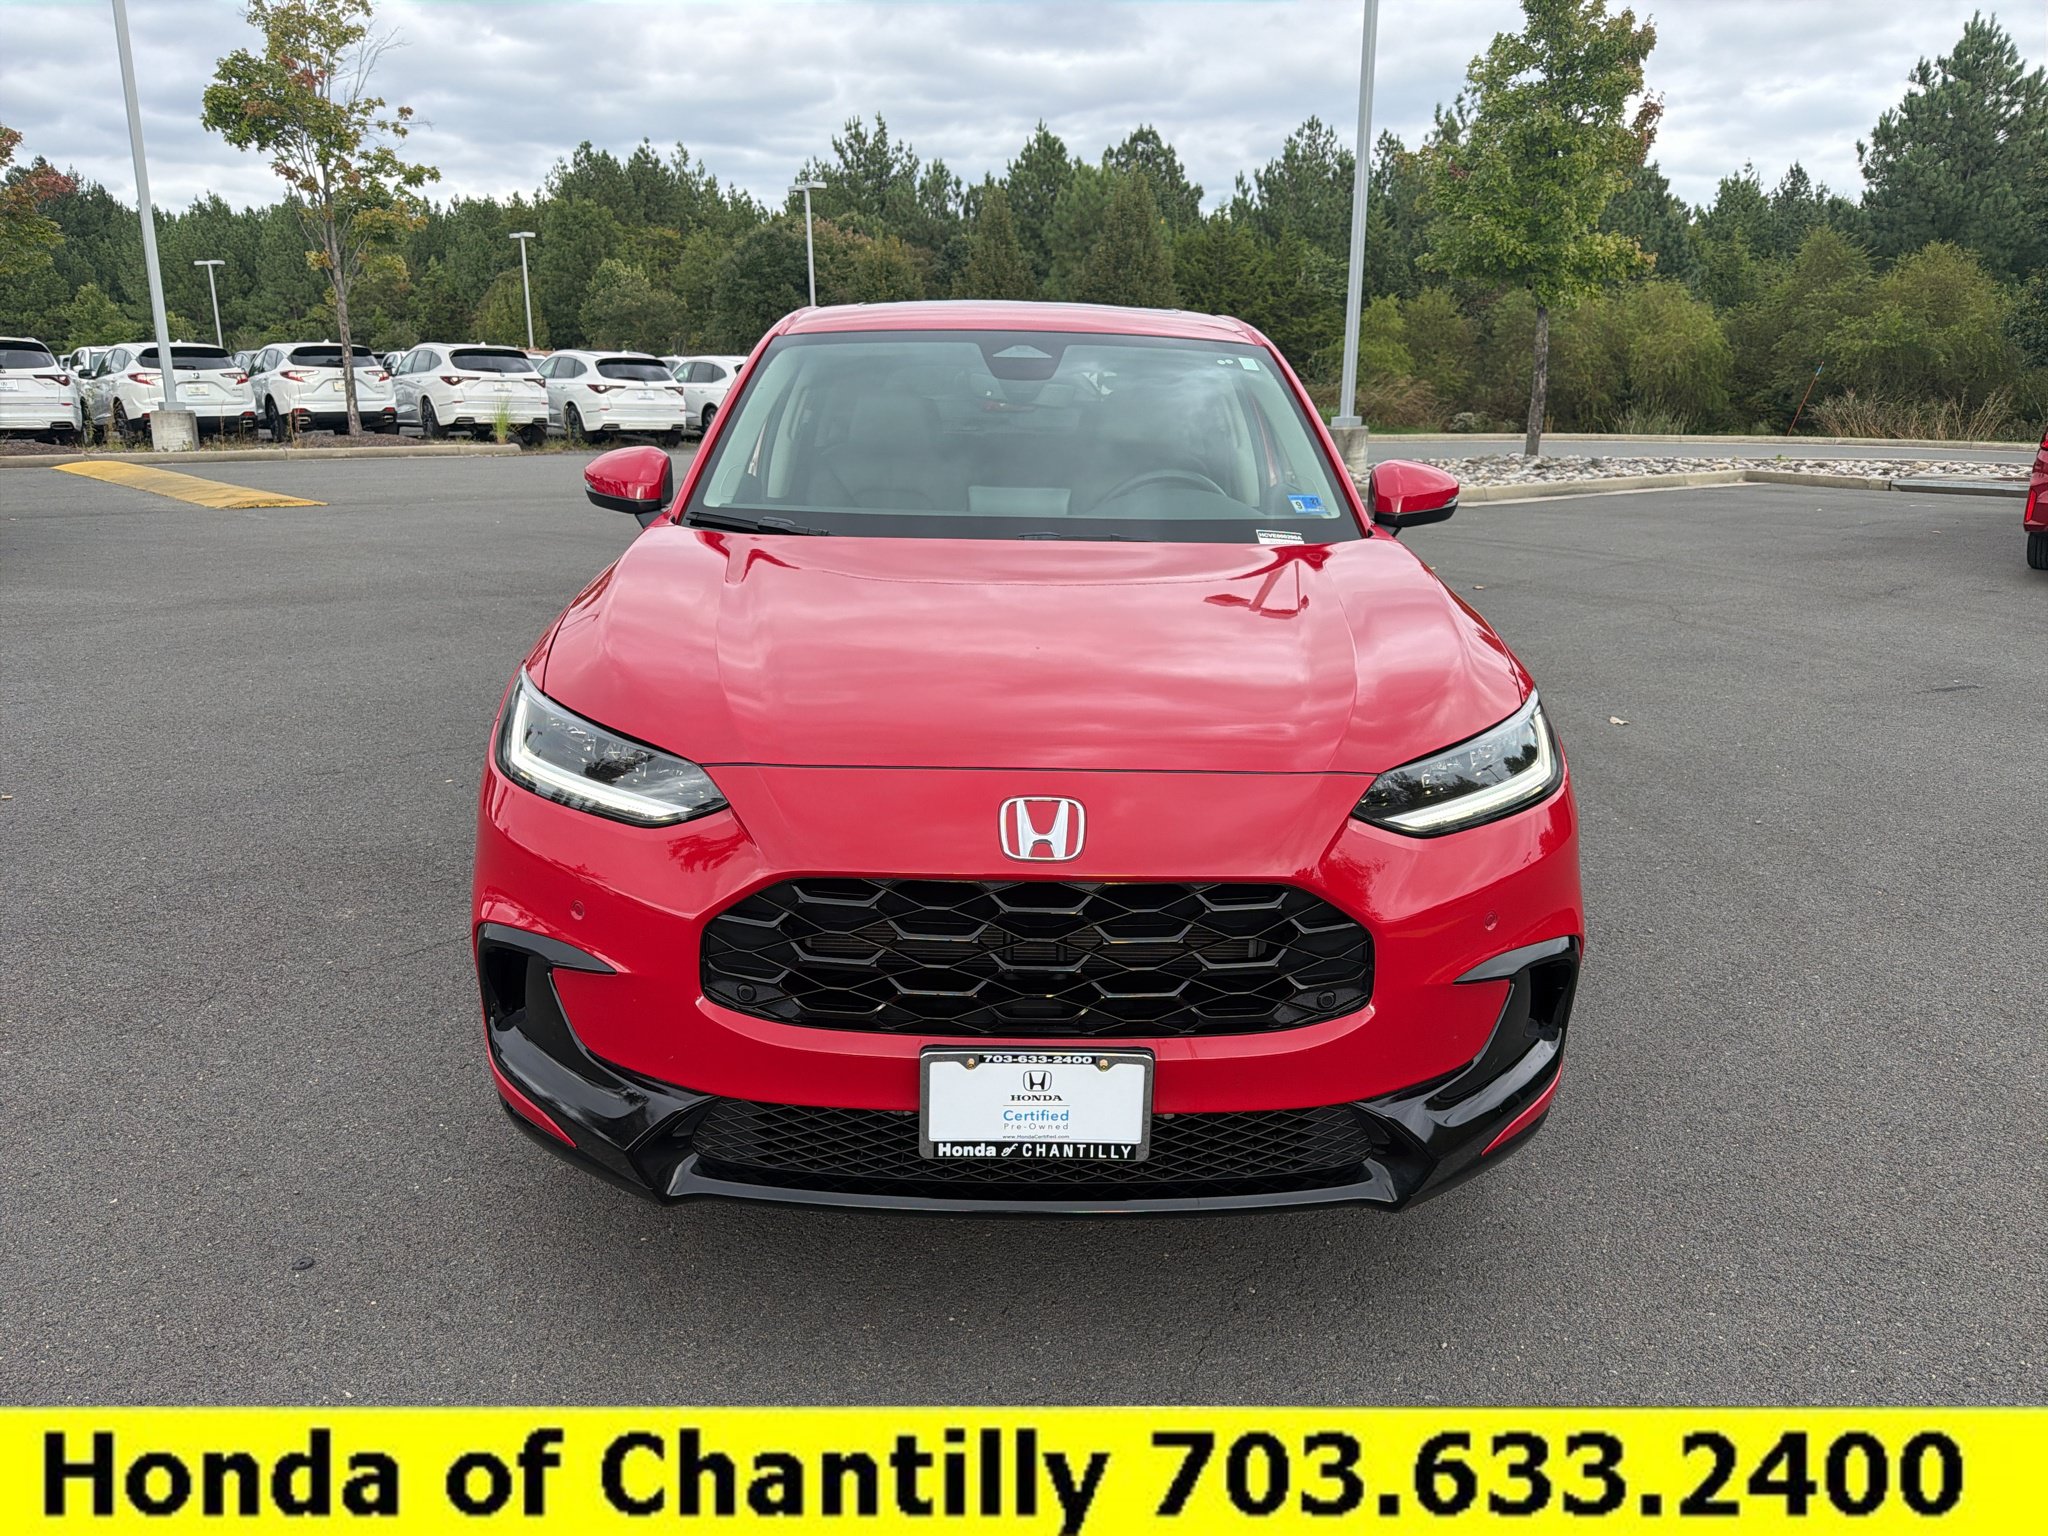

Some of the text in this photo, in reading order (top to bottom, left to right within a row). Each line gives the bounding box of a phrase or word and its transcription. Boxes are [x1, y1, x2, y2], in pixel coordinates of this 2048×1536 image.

[983, 1055, 1093, 1064] 703-633-2400
[1010, 1094, 1064, 1102] HONDA
[1003, 1109, 1070, 1121] Certified
[1003, 1122, 1069, 1130] Pre-Owned
[938, 1142, 1132, 1160] Honda of CHANTILLY
